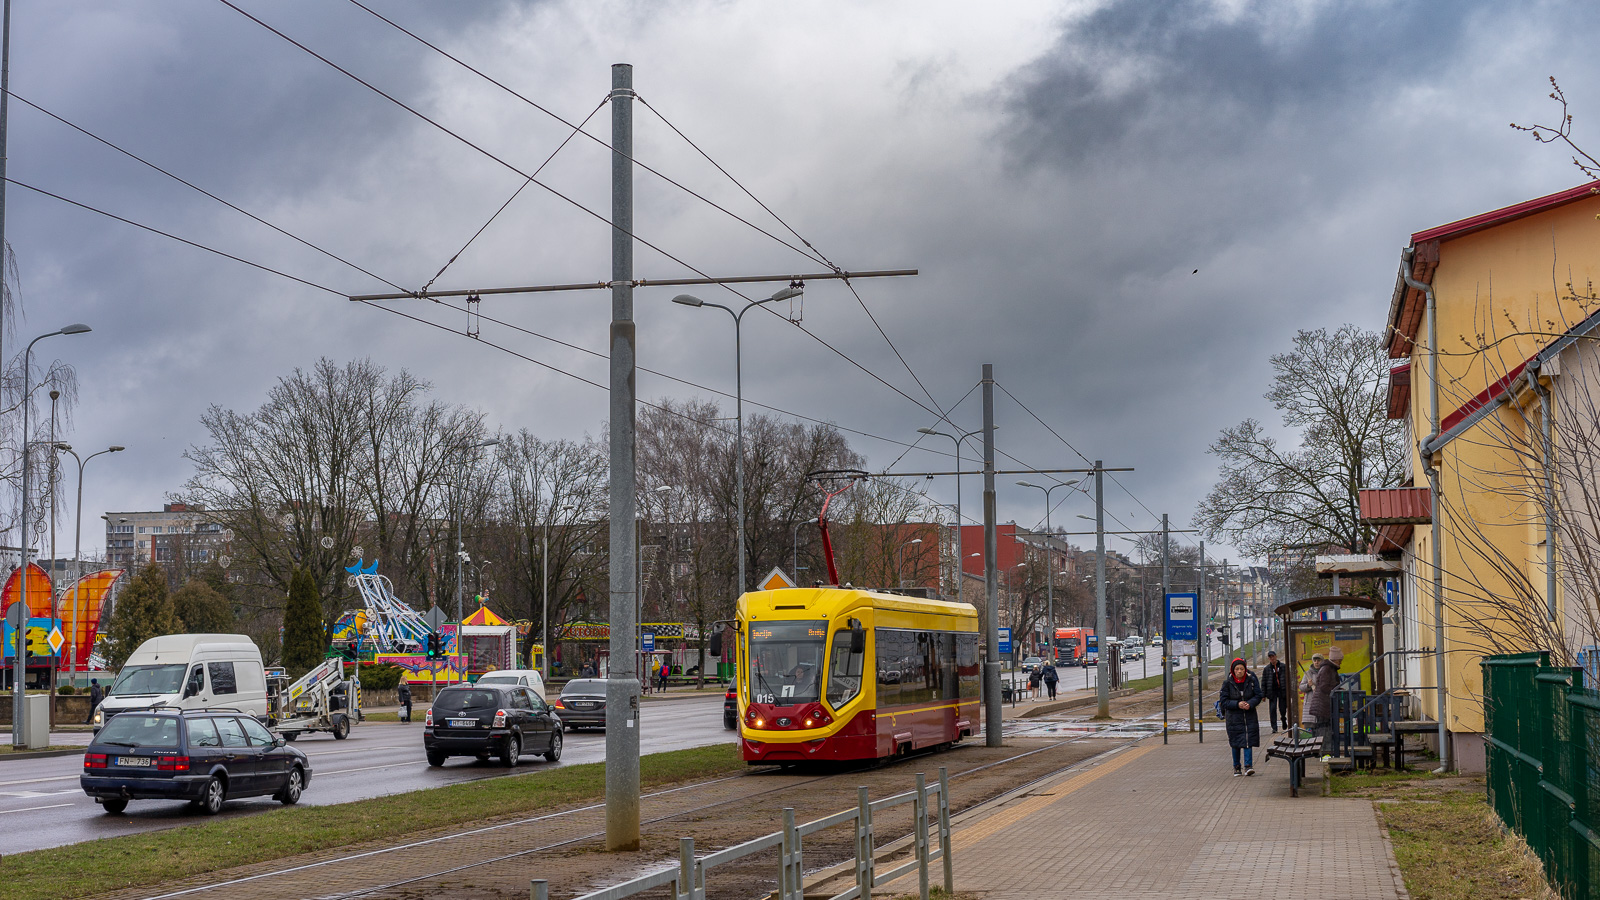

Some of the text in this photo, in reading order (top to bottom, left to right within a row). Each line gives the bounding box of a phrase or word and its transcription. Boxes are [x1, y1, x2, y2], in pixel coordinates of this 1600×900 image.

[561, 627, 611, 638] AUTODR
[784, 685, 792, 698] 1
[756, 693, 775, 704] 015
